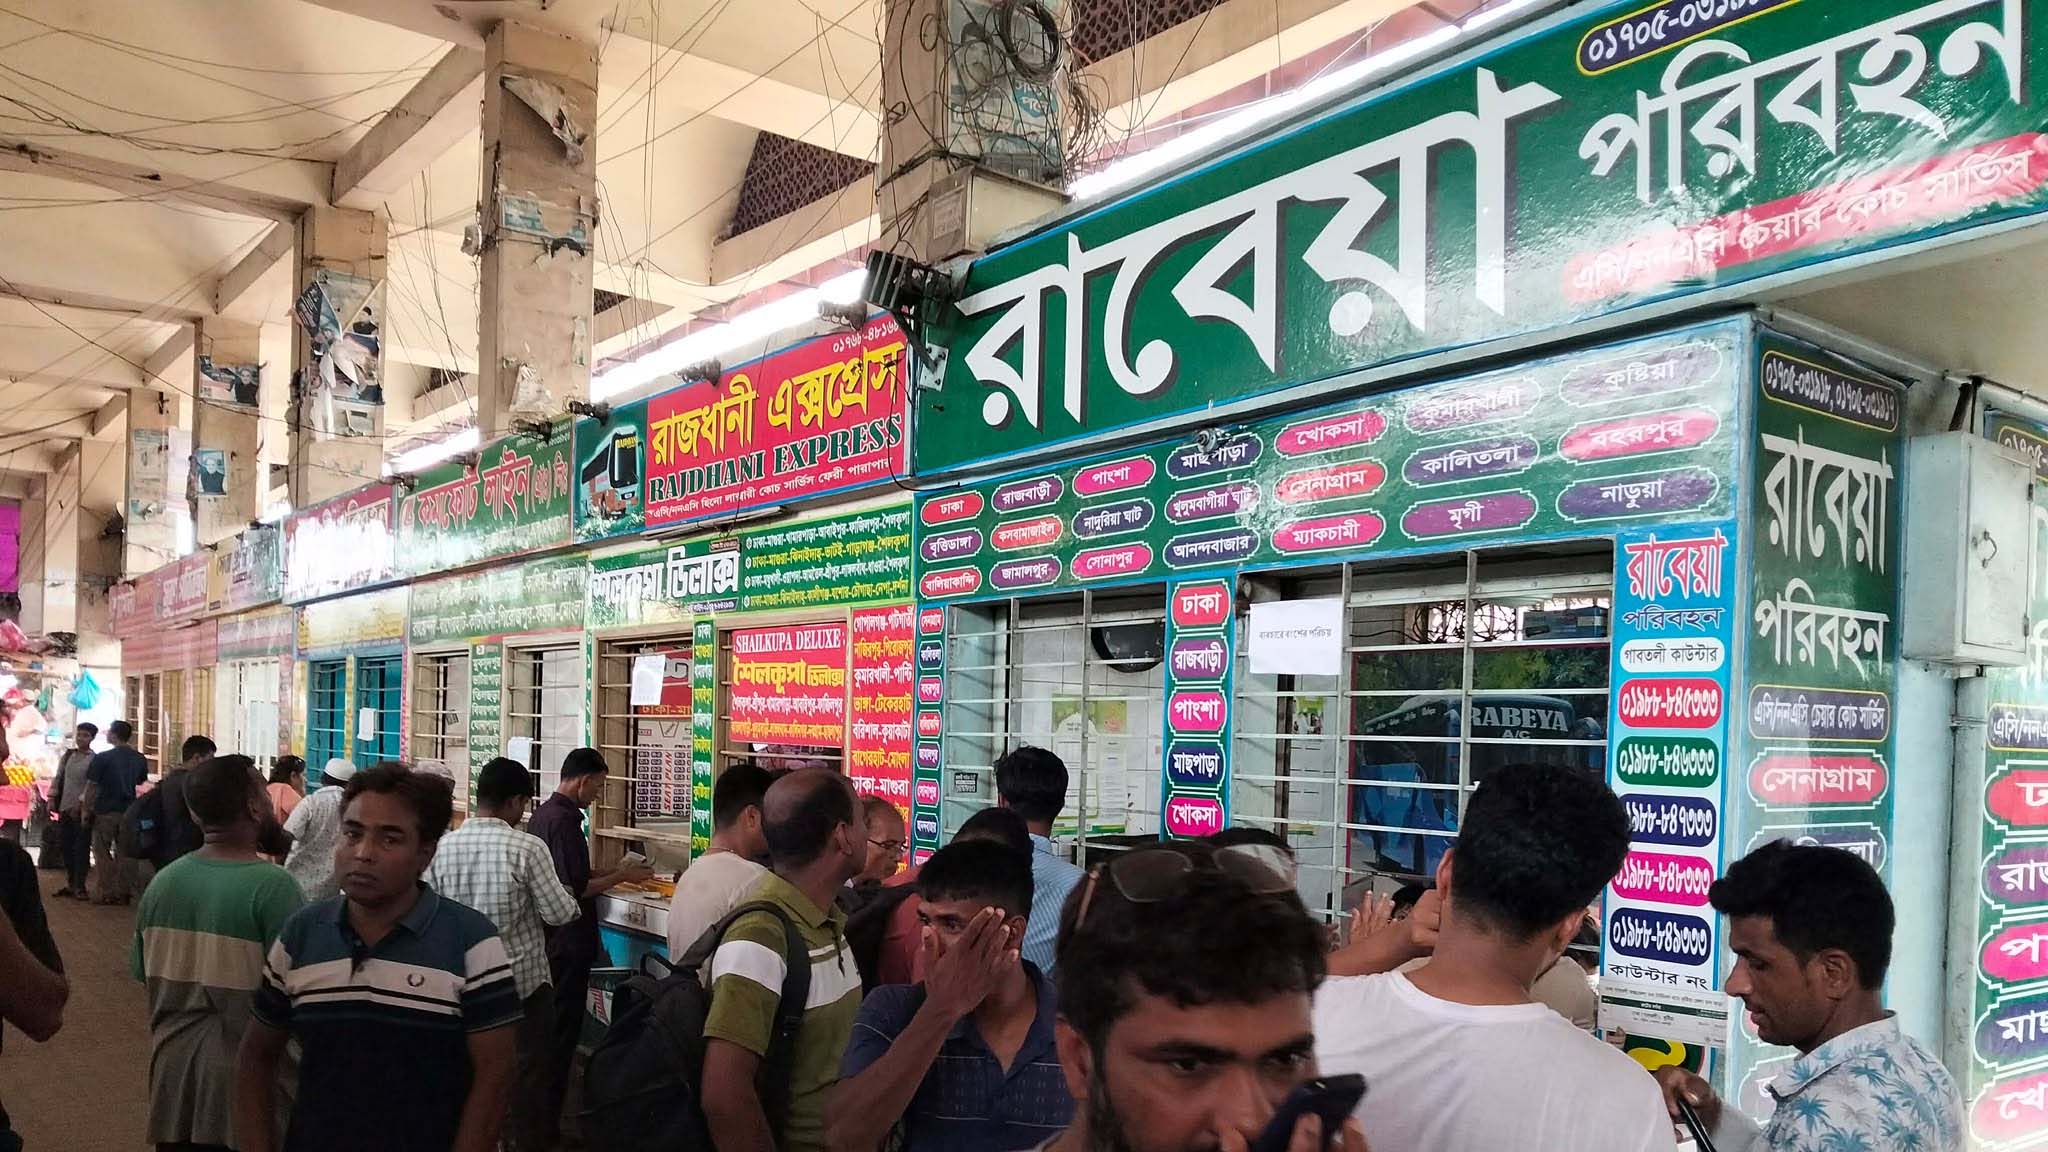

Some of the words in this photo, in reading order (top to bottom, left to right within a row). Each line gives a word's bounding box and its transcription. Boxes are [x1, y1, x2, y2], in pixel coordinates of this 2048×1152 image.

[1836, 182, 1910, 224] কোচ
[1924, 144, 2037, 201] সার্ভিস
[954, 66, 1562, 429] রাবেয়া
[1579, 0, 2024, 207] পরিবহন
[1604, 357, 1679, 390] কুষ্টিয়া
[650, 373, 759, 467] রাজধানী
[768, 342, 905, 432] এক্সপ্রেস
[1296, 416, 1365, 446] খোকসা
[1589, 416, 1686, 449] বহরপুর
[648, 450, 766, 504] RAJDHANI
[773, 413, 903, 476] EXPRESS
[1421, 443, 1521, 475] কালিতলা
[482, 445, 533, 527] লাইন
[758, 483, 780, 497] কোচ
[784, 473, 815, 491] সার্ভিস
[818, 466, 844, 484] ফেরী
[847, 456, 893, 477] পারাপার
[1091, 465, 1131, 486] পাংশা
[1289, 468, 1369, 496] সেনাগ্রাম
[940, 500, 965, 515] ঢাকা
[1001, 481, 1053, 506] রাজবাড়ী
[1231, 486, 1252, 507] ঘাট
[1761, 424, 1894, 576] রাবেয়া
[1083, 510, 1121, 532] নাদুরিয়া
[1123, 505, 1143, 524] ঘাট
[1447, 499, 1484, 530] মৃগী
[998, 521, 1056, 543] কসবামাজাইল
[1292, 518, 1360, 546] ম্যাকচামী
[1173, 535, 1251, 558] আনন্দবাজার
[667, 545, 741, 599] ডিলাক্স
[1001, 562, 1049, 581] জামালপুর
[1086, 551, 1135, 571] সোনাপুর
[1624, 528, 1728, 602] রাবেয়া
[925, 572, 976, 593] বালিয়াকান্দি
[1180, 591, 1222, 616] ঢাকা
[1622, 604, 1726, 632] পরিবহন
[1755, 577, 1890, 682] পরিবহন
[736, 632, 793, 653] SHAILKUPA
[796, 628, 841, 650] DELUXE
[1624, 643, 1667, 664] গাবতলী
[1671, 642, 1719, 663] কাউন্টার
[1174, 641, 1224, 673] রাজবাড়ী
[1174, 697, 1221, 723] পাংশা
[1622, 685, 1718, 719] ০১৯৮৮-৮৪৫৩৩৩
[1838, 704, 1858, 729] কোচ
[1859, 697, 1886, 731] সার্ভিস
[852, 718, 911, 746] বরিশাল-কুয়াকাটা
[1470, 706, 1569, 732] RABEYA
[1502, 730, 1532, 740] A/C
[1172, 751, 1219, 778] মাছপাড়া
[1620, 743, 1714, 777] ০১৯৮৮-৮৪৬৩৩৩
[1762, 765, 1877, 793] সেনাগ্রাম
[1171, 803, 1217, 829] খোকসা
[1626, 801, 1713, 838] ১৯৮৮-৮৪৭৩৩৩
[1613, 917, 1708, 958] ০১৯৮৮-৮৪৯৩৩৩
[1608, 963, 1679, 991] কাউন্টার
[1684, 974, 1710, 991] নং
